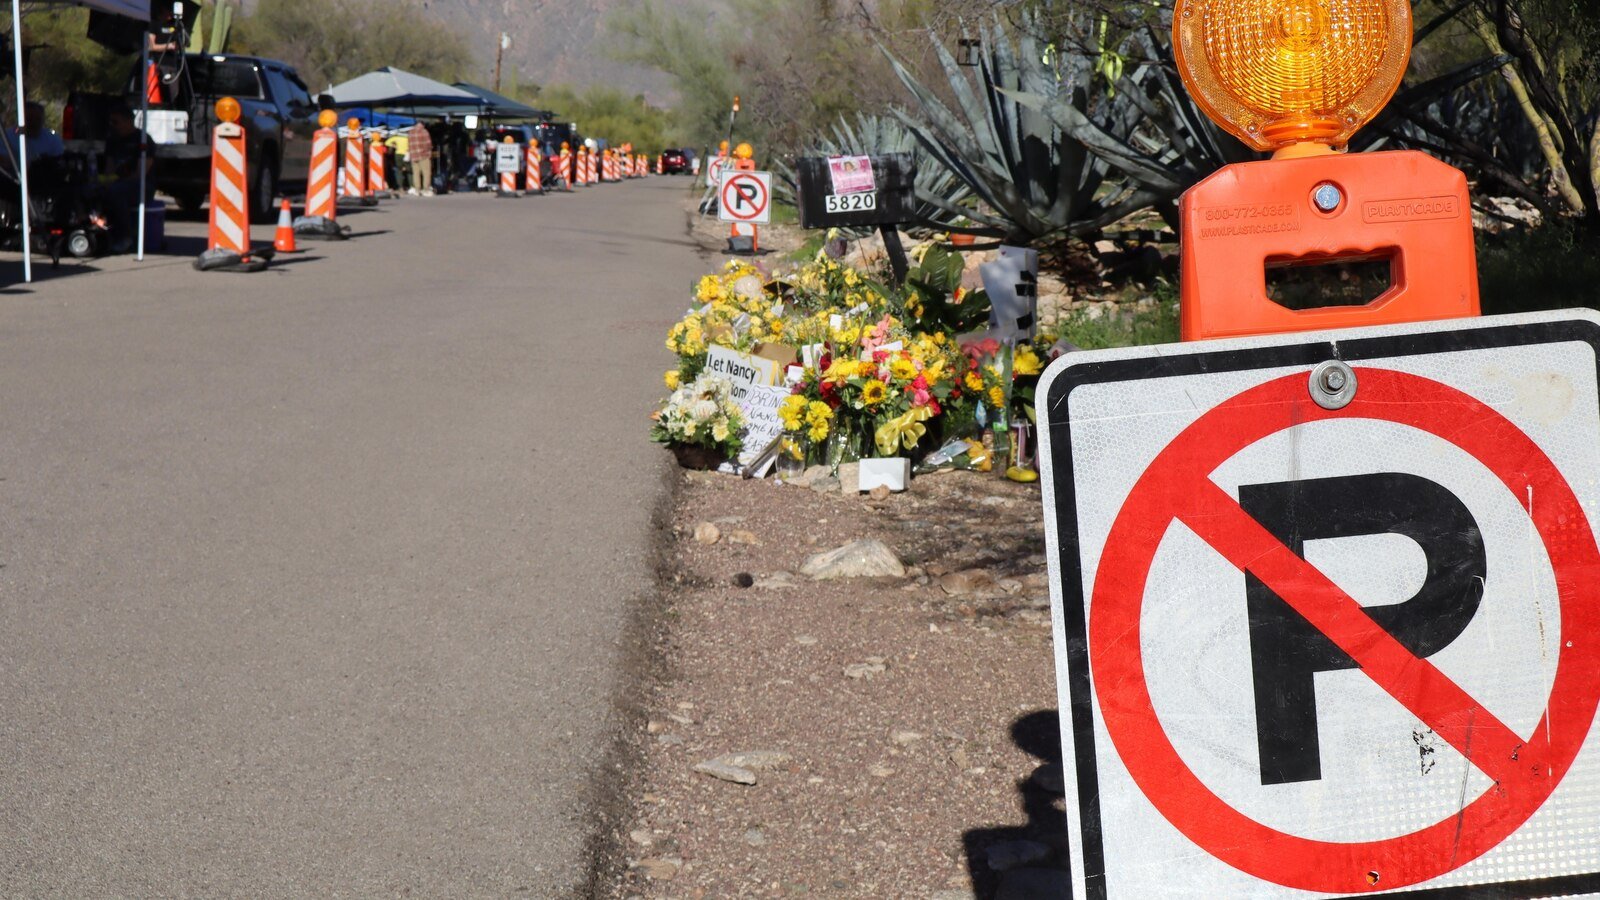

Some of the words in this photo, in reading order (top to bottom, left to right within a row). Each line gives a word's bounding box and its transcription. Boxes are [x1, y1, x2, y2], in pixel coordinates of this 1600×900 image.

[736, 184, 758, 210] P
[829, 194, 873, 211] 5820
[1367, 202, 1453, 217] PLASTICADE
[1200, 221, 1301, 238] WWW.PLASTICADE.COM
[708, 354, 724, 373] Let
[726, 359, 757, 385] Nancy
[1238, 472, 1487, 786] P
